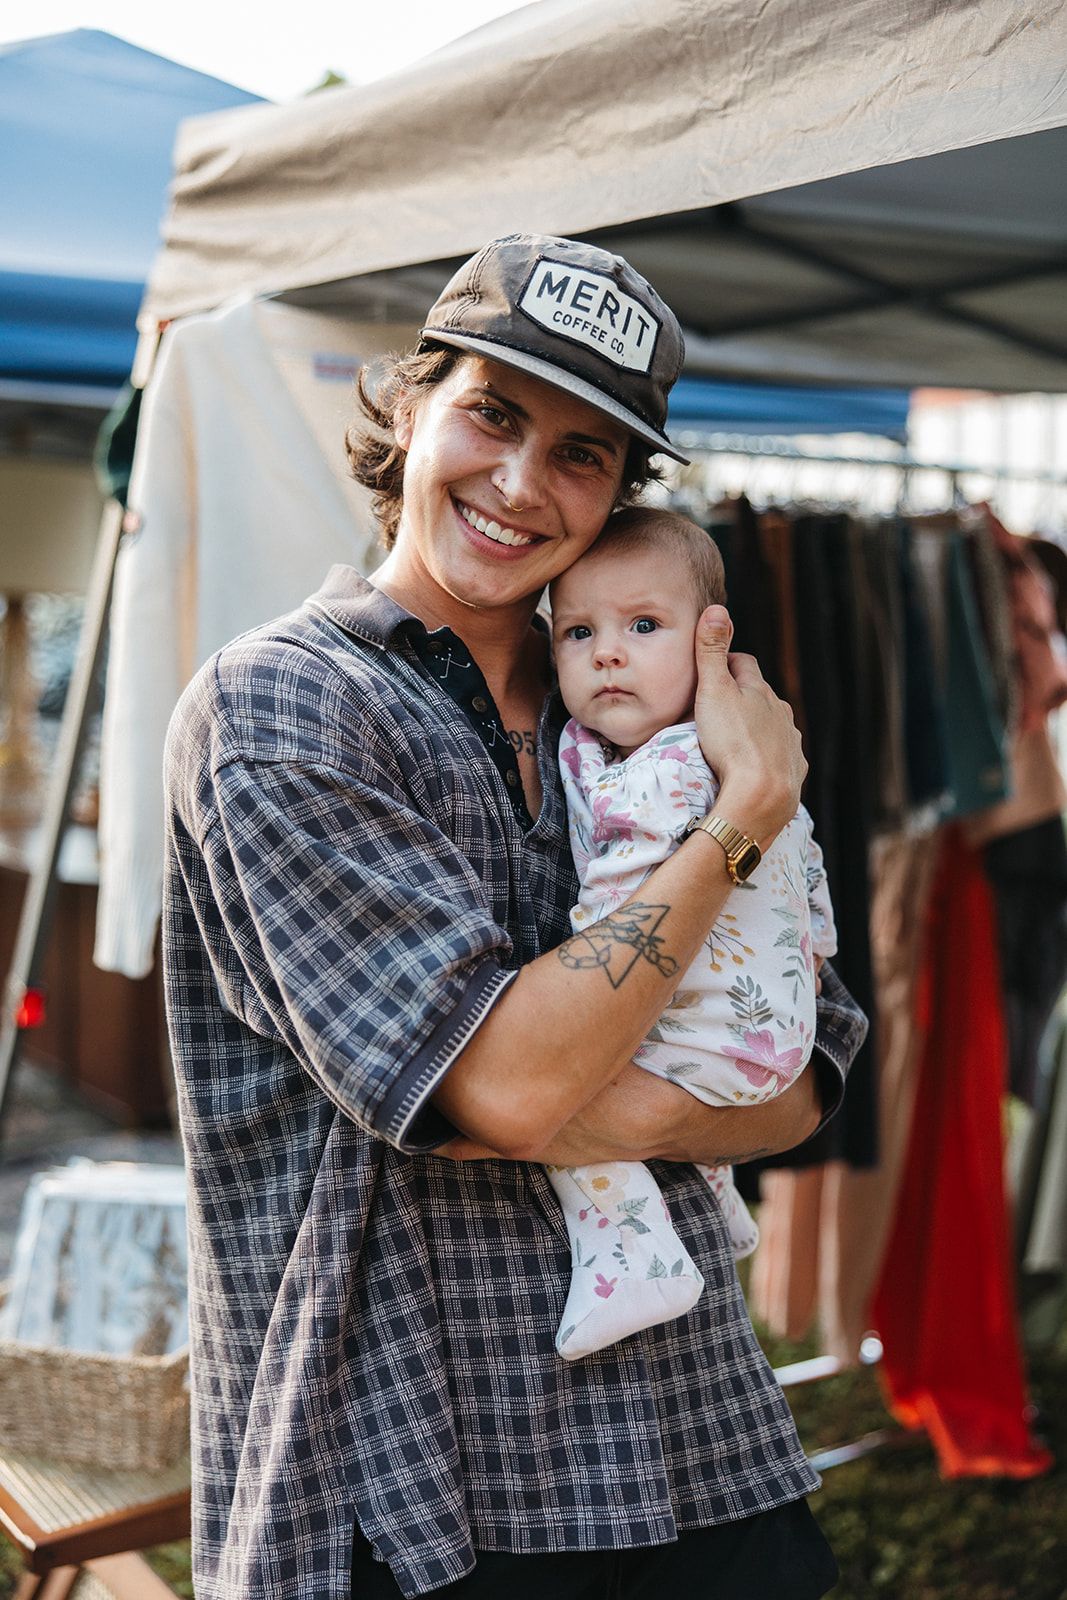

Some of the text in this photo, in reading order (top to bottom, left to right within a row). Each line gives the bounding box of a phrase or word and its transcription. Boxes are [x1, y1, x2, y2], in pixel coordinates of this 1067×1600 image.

[536, 271, 650, 347] MERIT
[553, 311, 624, 356] COFFEE CO.
